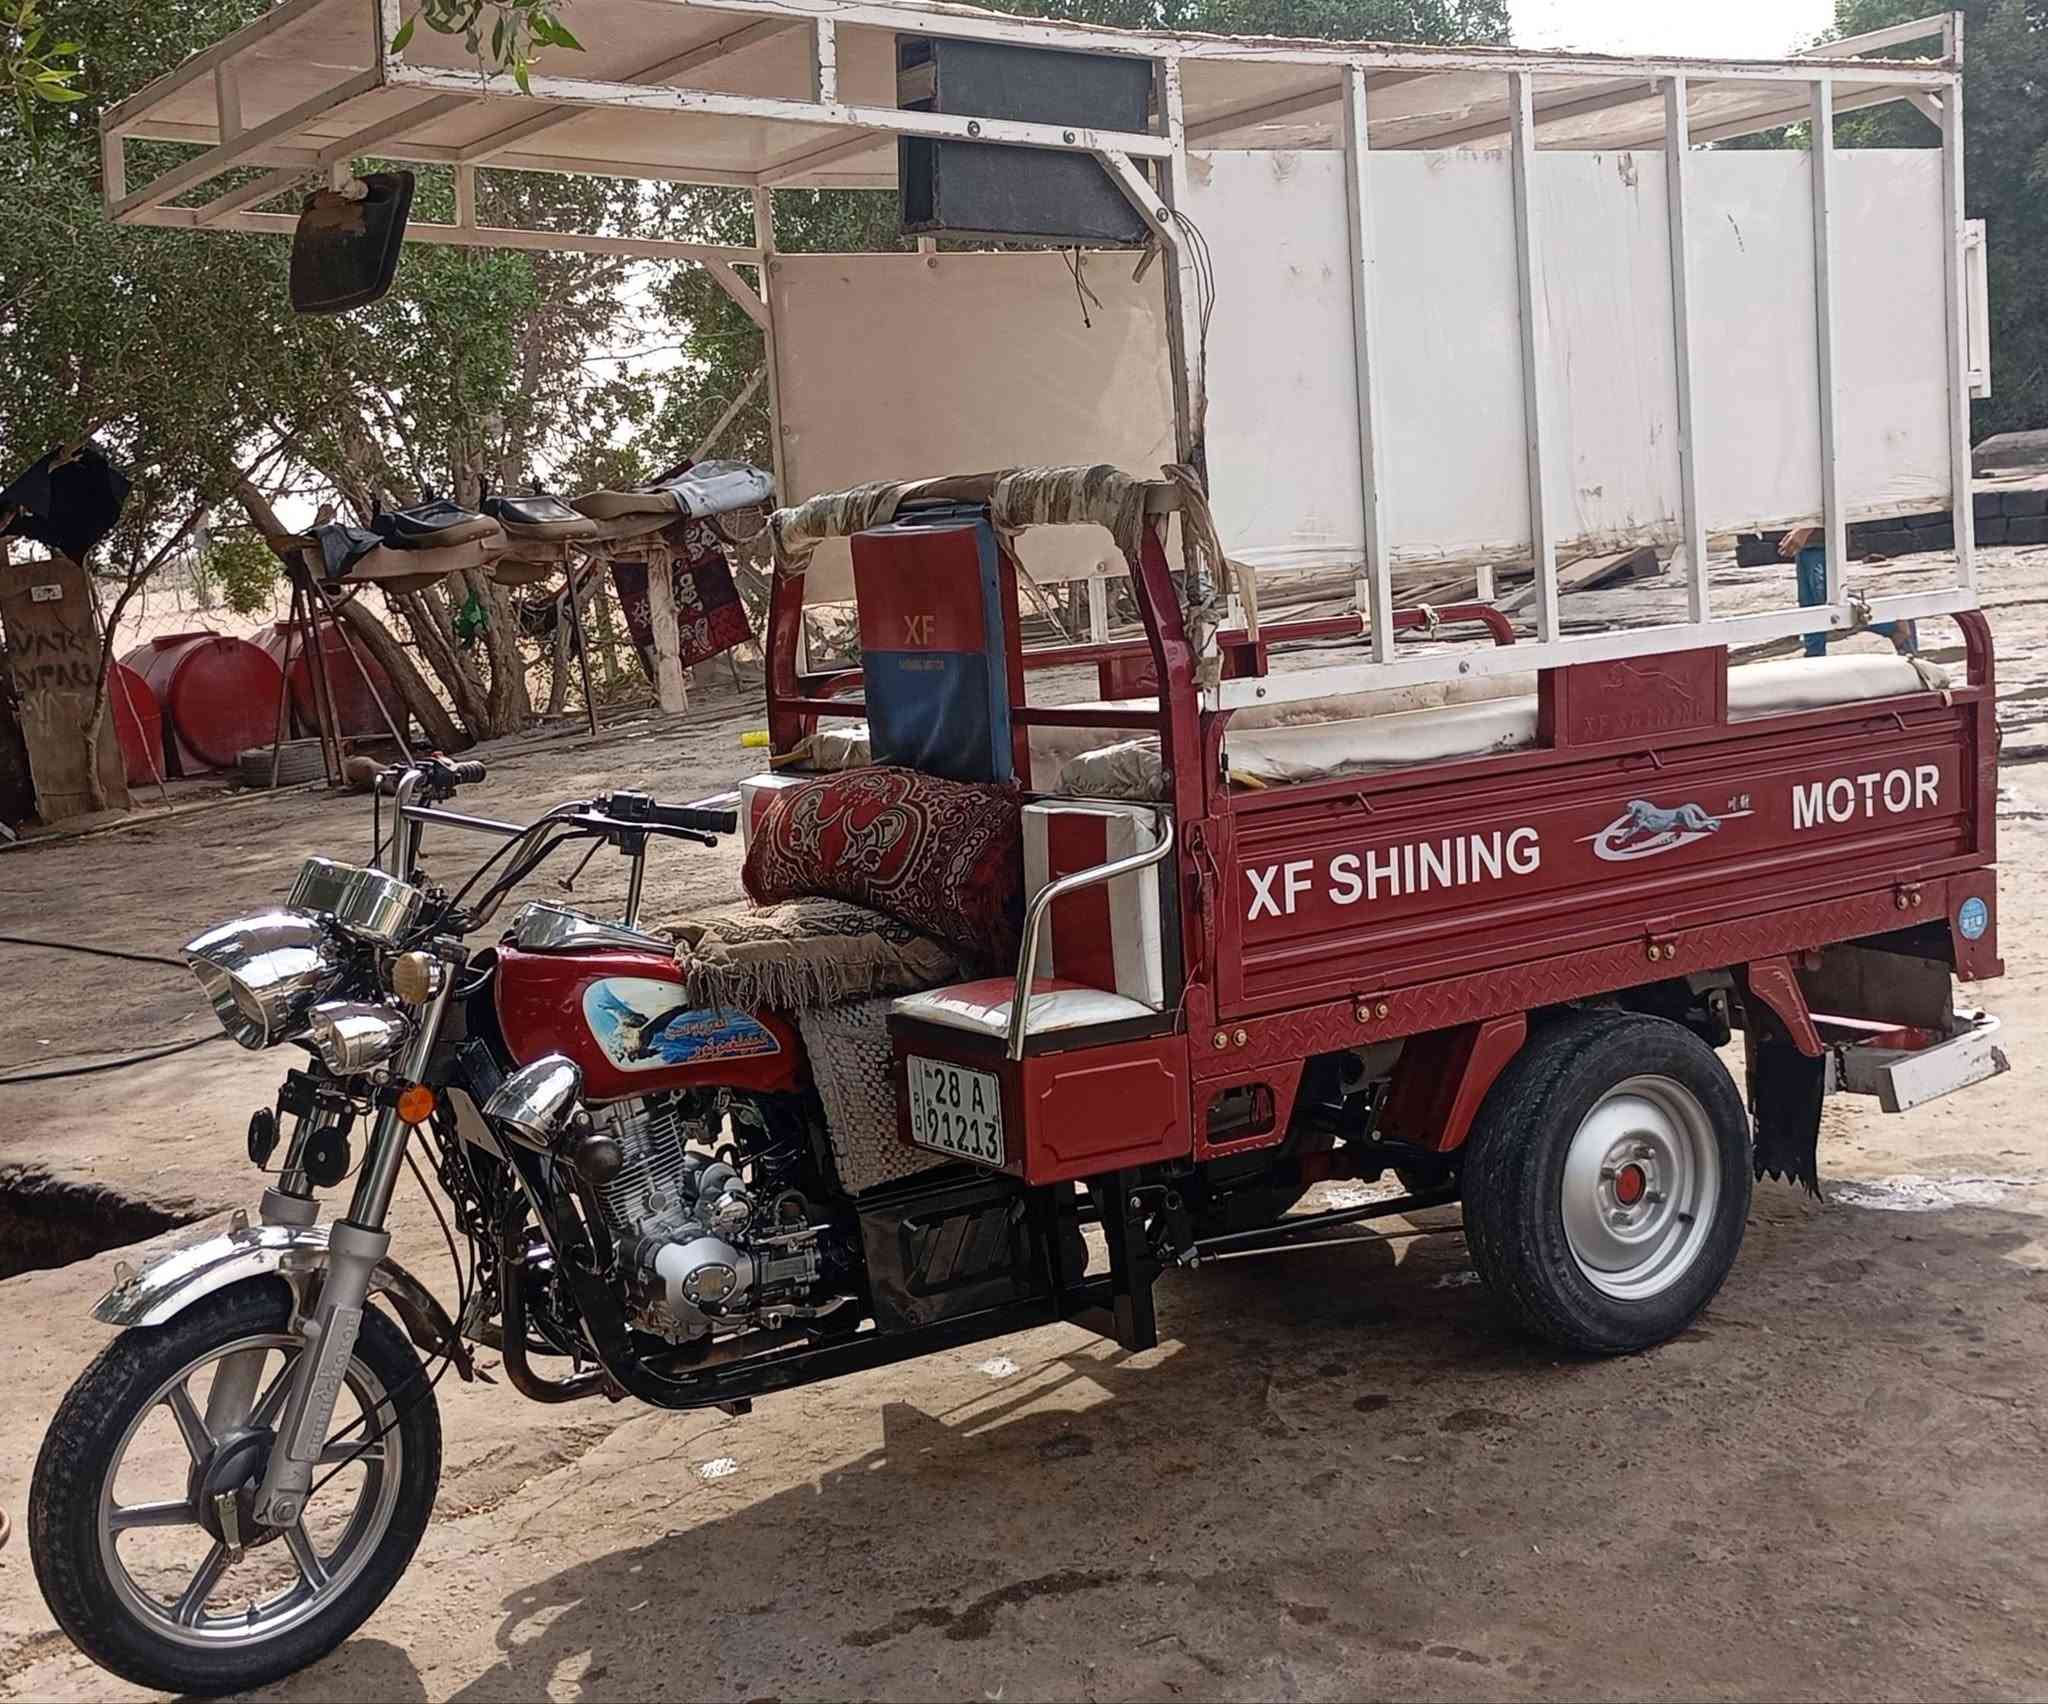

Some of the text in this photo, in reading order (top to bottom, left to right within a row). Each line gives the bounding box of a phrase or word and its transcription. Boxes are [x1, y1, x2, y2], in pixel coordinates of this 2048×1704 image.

[903, 615, 936, 646] XF
[1245, 764, 1940, 921] XF SHINING MOTOR
[934, 1068, 985, 1114] 28 A
[927, 1107, 998, 1160] 91213
